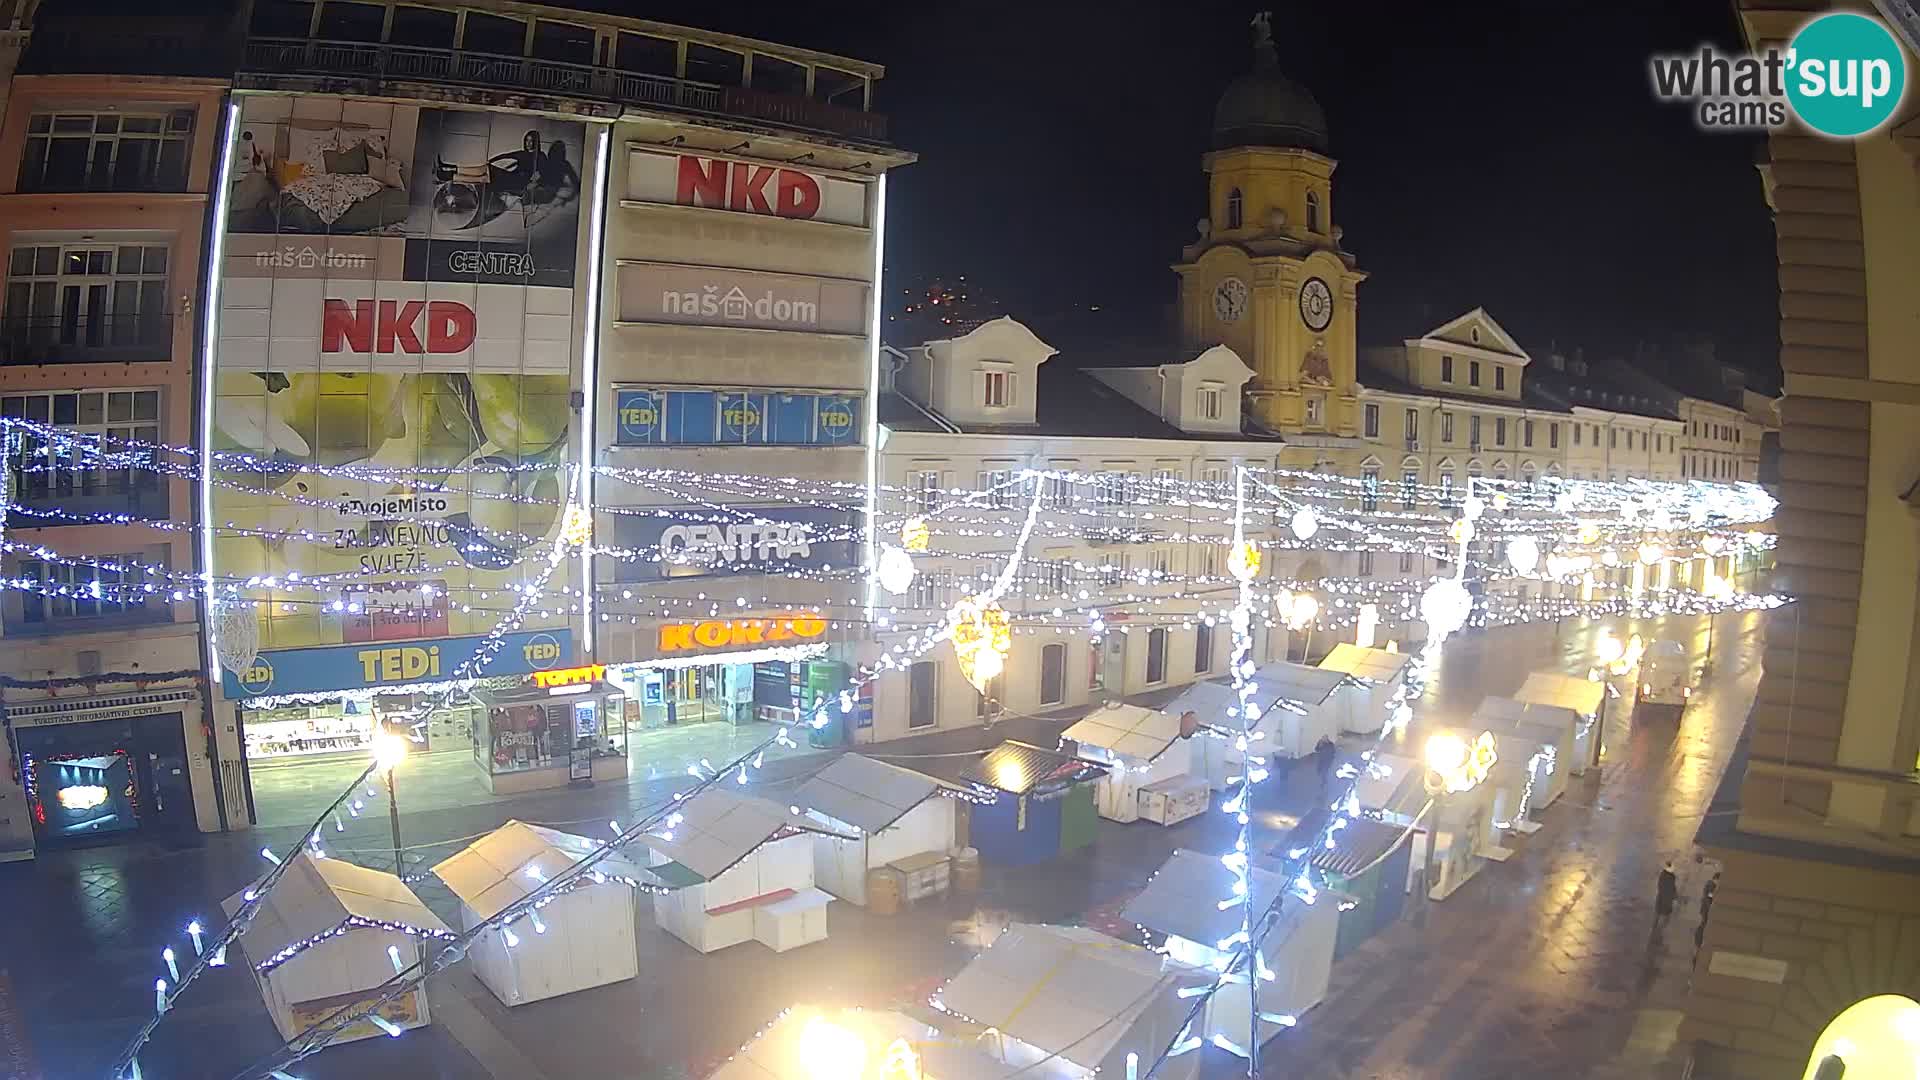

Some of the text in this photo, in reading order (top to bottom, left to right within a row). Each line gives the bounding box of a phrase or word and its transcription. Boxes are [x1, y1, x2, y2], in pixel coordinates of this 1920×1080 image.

[677, 155, 820, 220] NKD
[256, 247, 366, 268] naš dom
[449, 250, 535, 276] CENTRA
[662, 285, 816, 323] naš dom
[322, 299, 477, 353] NKD
[620, 409, 658, 426] TEDi
[724, 410, 760, 426] TEDi
[339, 498, 446, 516] #TvojeMisto
[659, 523, 809, 564] CENTRA
[523, 643, 560, 660] TEDi
[359, 646, 440, 682] TEDi
[534, 665, 604, 688] TOMMY
